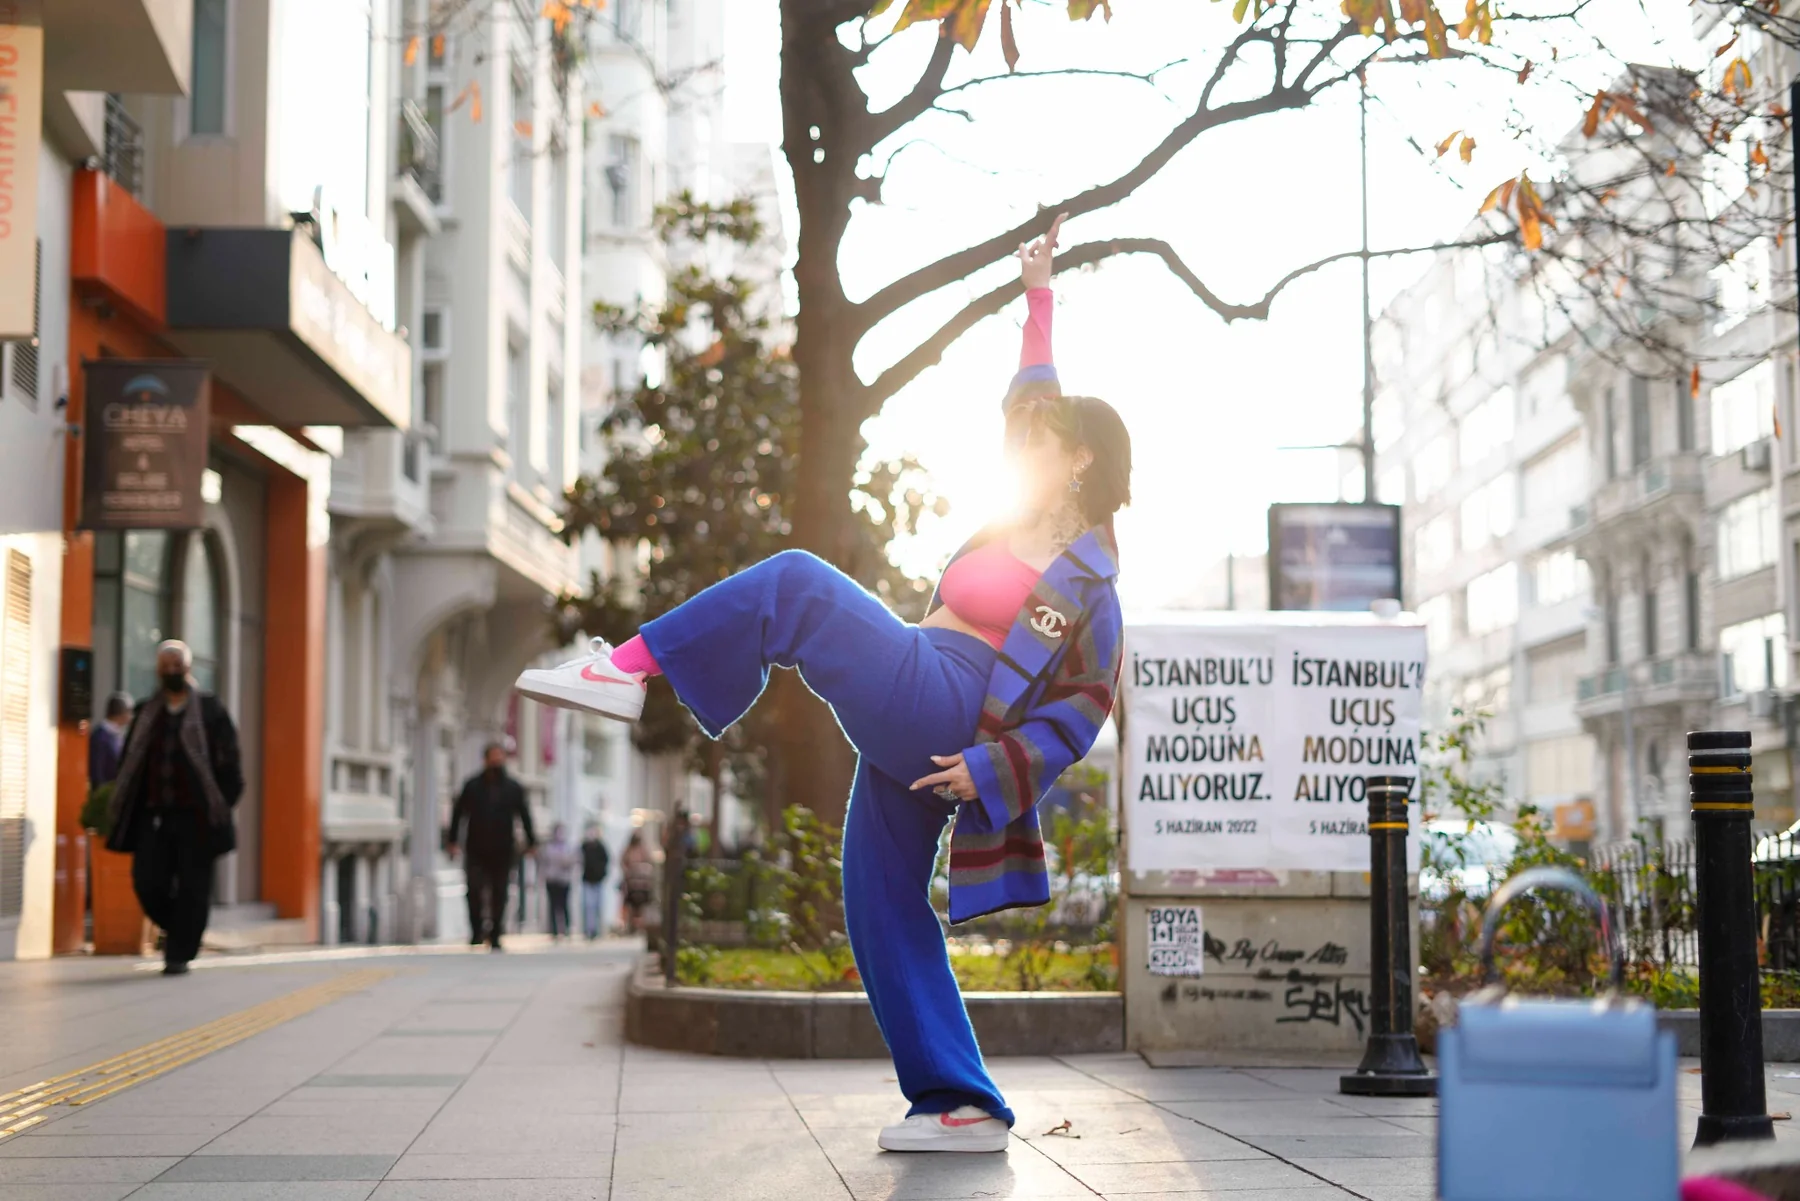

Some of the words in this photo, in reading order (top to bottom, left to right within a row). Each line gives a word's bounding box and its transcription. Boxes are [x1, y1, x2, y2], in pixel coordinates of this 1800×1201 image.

[1133, 652, 1273, 687] İSTANBUL'U
[1172, 696, 1236, 731] UÇUŞ
[1330, 697, 1395, 734] UÇUŞ
[1146, 734, 1263, 763] MODUNA
[1303, 735, 1416, 765] MODUNA
[1139, 773, 1272, 801] ALIYORUZ.
[1155, 819, 1163, 834] 5
[1166, 816, 1222, 834] HAZİRAN
[1227, 819, 1257, 834] 2022
[1309, 821, 1317, 835] 5
[1321, 817, 1368, 836] HAZİRA
[1151, 908, 1198, 925] BOYA
